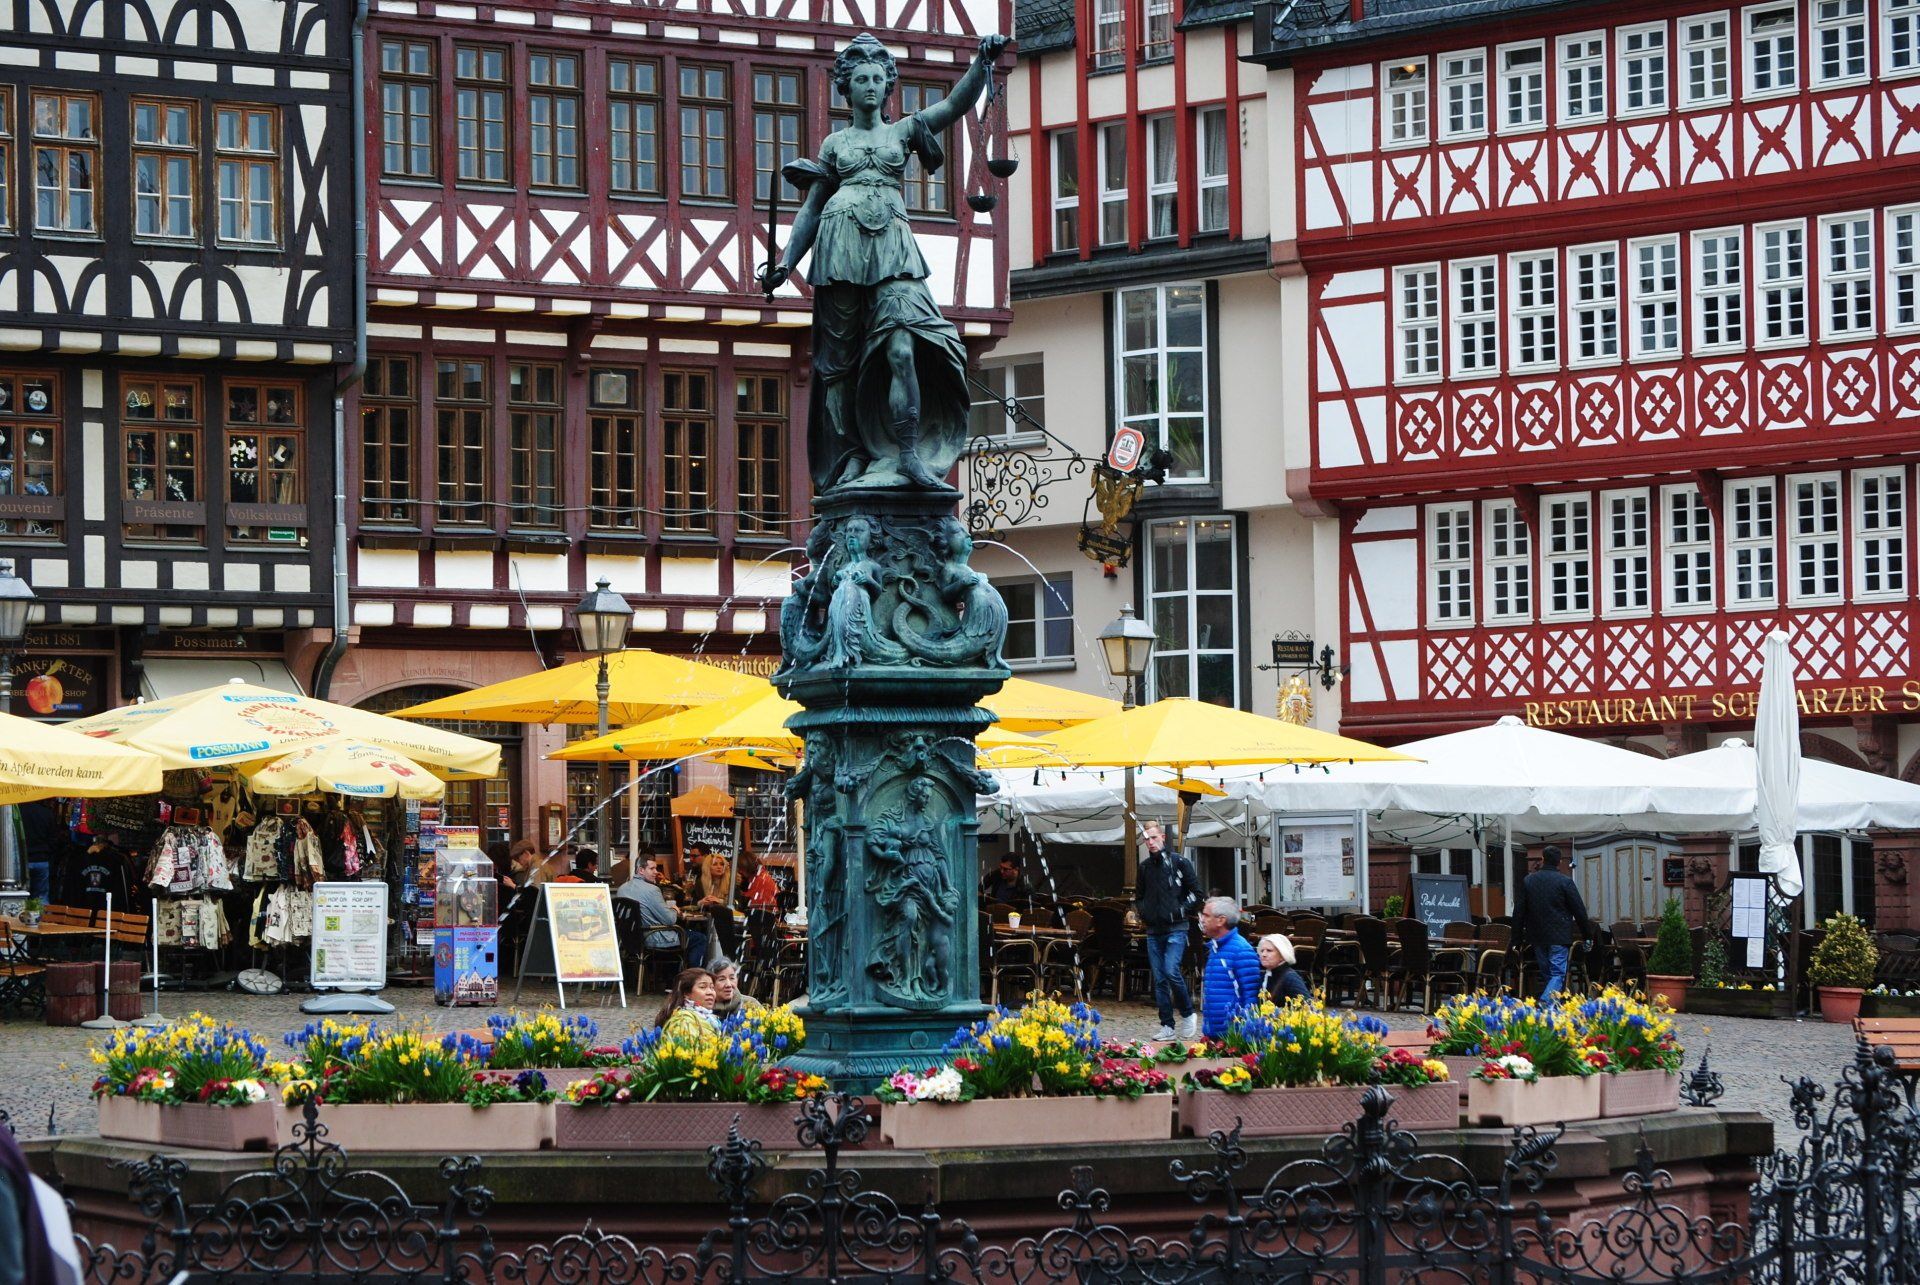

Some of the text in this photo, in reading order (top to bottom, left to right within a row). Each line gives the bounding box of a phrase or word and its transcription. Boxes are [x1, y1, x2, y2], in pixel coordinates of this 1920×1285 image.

[0, 502, 53, 514] ouvenir
[135, 505, 194, 519] Präsente
[228, 508, 304, 522] Volkskunst
[24, 632, 81, 646] Seit 1881
[1524, 680, 1920, 727] RESTAURANT SCHARZER S
[196, 740, 265, 758] POSSMANN
[10, 762, 36, 776] Apfel
[37, 766, 74, 778] werden
[76, 766, 104, 780] kann.
[340, 784, 382, 794] POSSMANN
[1420, 893, 1436, 906] Pork
